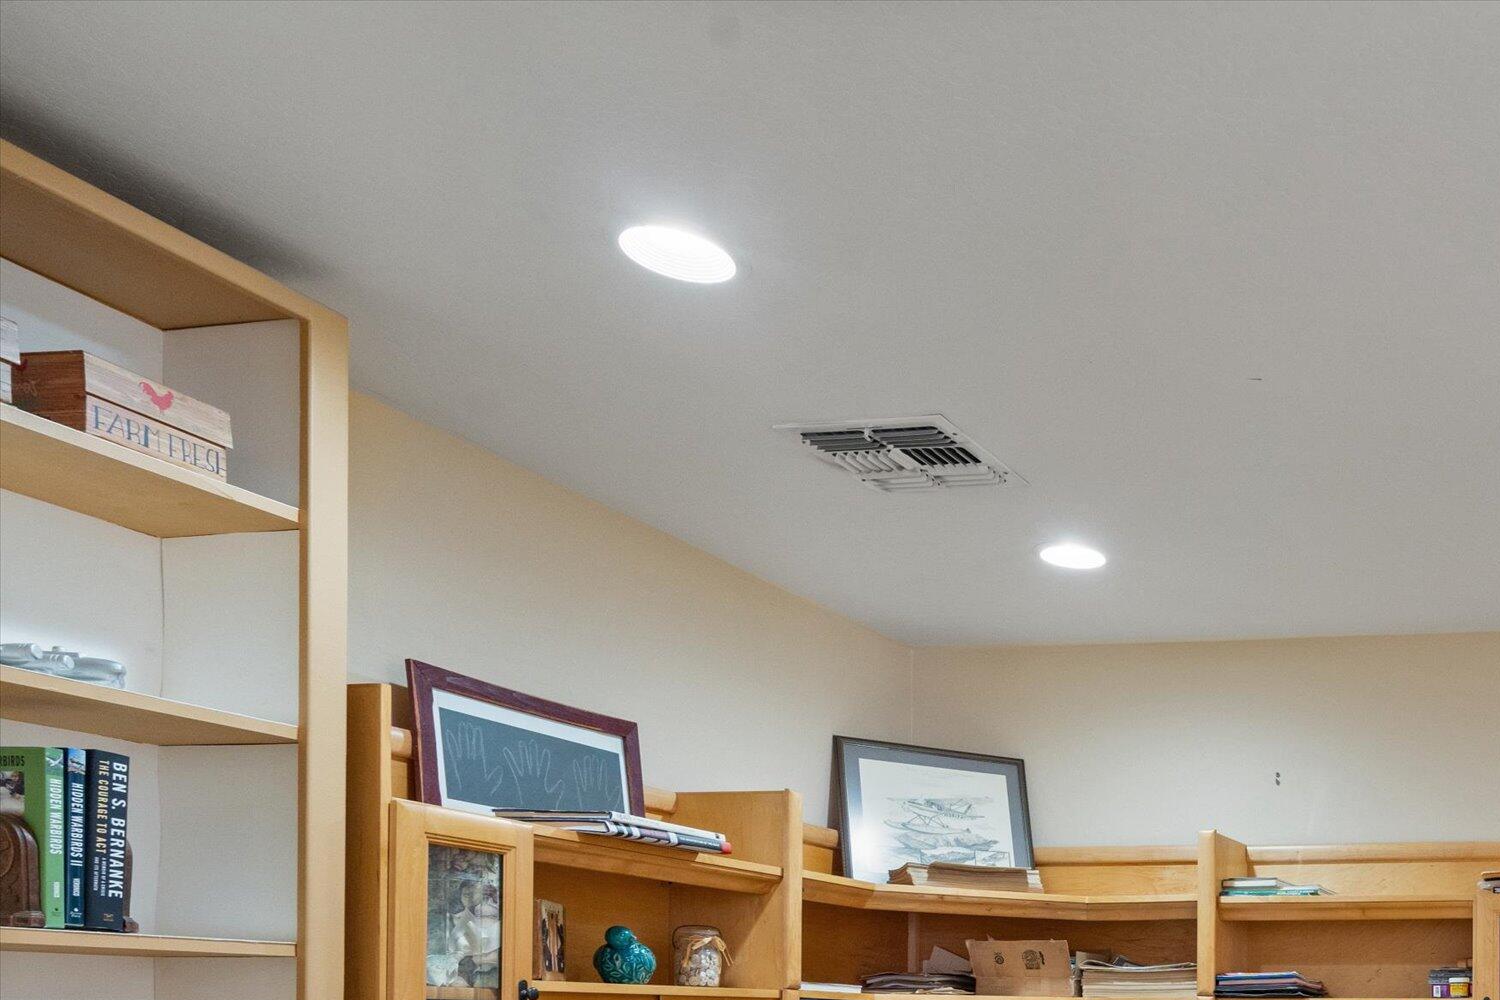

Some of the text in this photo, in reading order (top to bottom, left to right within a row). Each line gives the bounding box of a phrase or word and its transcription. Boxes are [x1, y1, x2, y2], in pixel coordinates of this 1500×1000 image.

[93, 405, 160, 452] FARM
[95, 760, 110, 854] THE COURAGE TO ACT
[111, 798, 126, 810] S.
[112, 762, 127, 793] BEN
[49, 778, 62, 855] HIDDEN WARBIRDS
[70, 782, 84, 867] HIDDEN WARBIRDS II
[108, 817, 125, 898] BERNANKE
